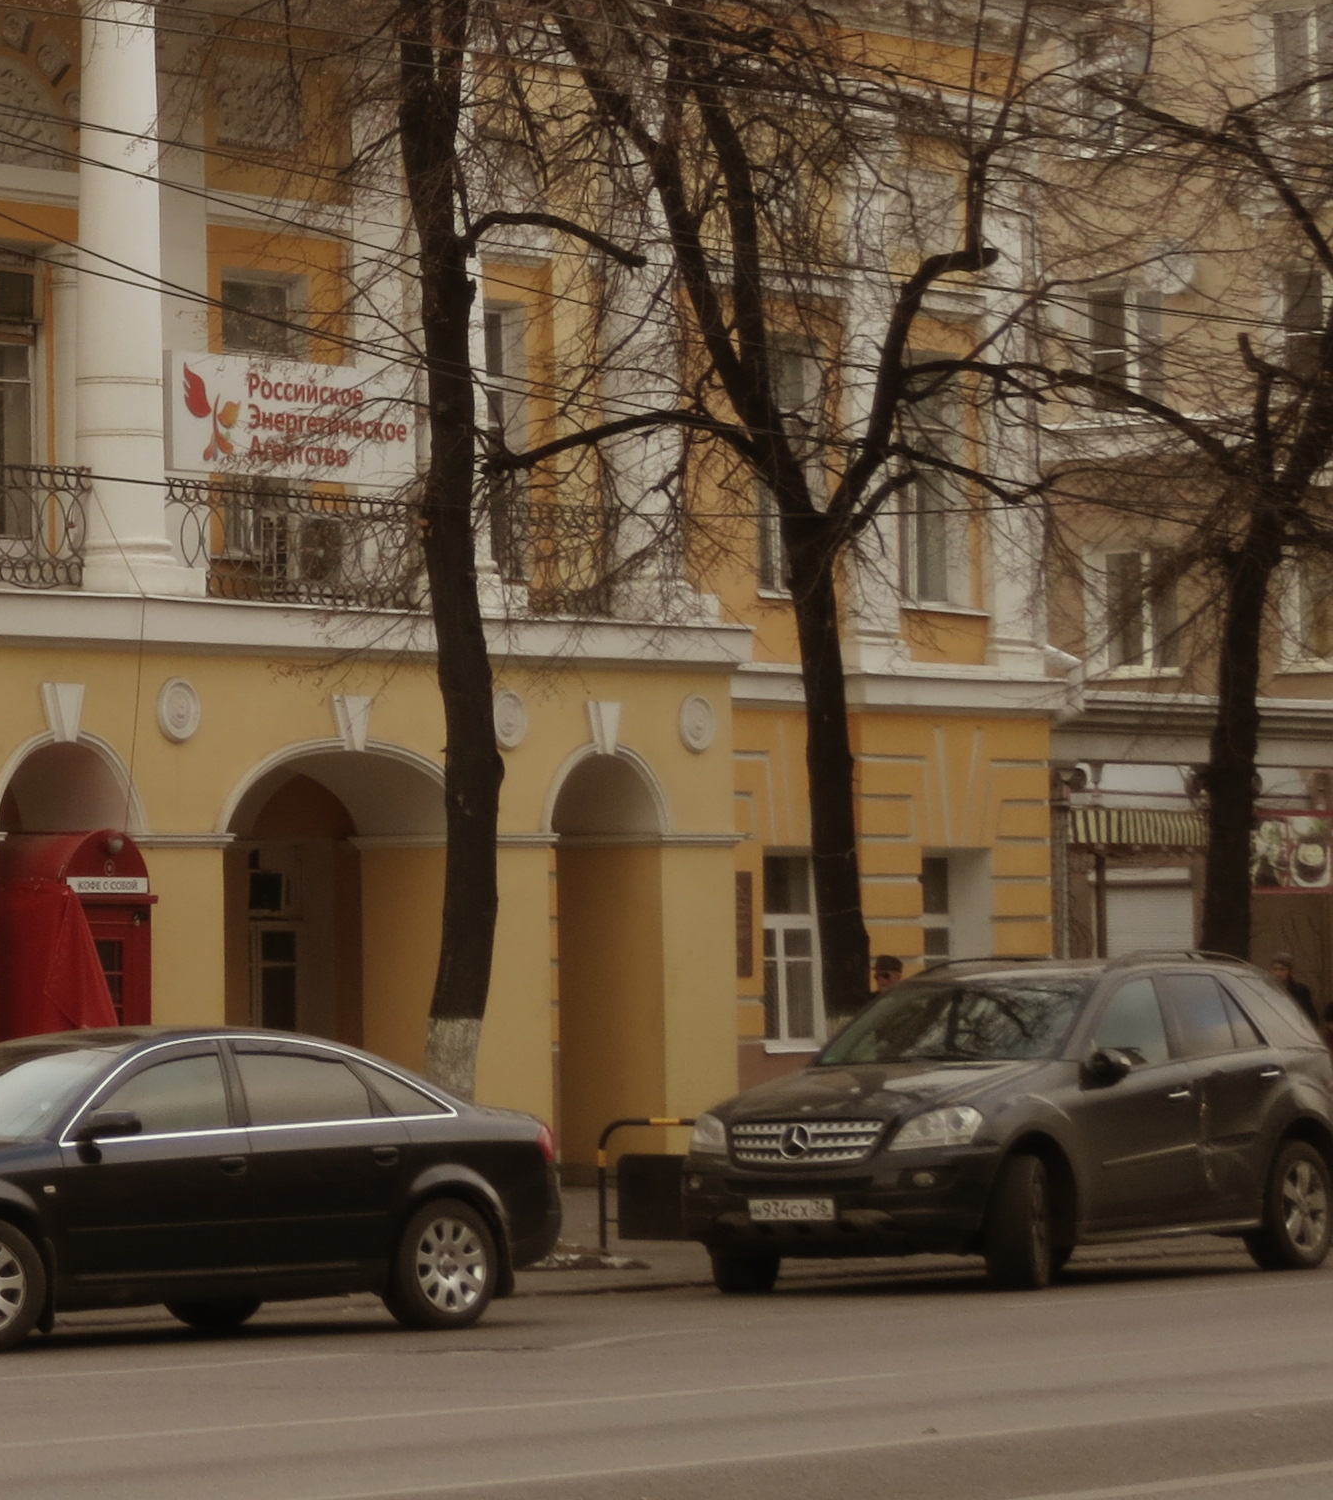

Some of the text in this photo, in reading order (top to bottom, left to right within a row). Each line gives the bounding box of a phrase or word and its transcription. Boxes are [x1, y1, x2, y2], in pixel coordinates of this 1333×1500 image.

[248, 372, 364, 406] Российское
[247, 404, 408, 443] Энергетическое
[248, 435, 349, 468] Агентство
[78, 879, 139, 891] КОФЕ С СОБОЙ
